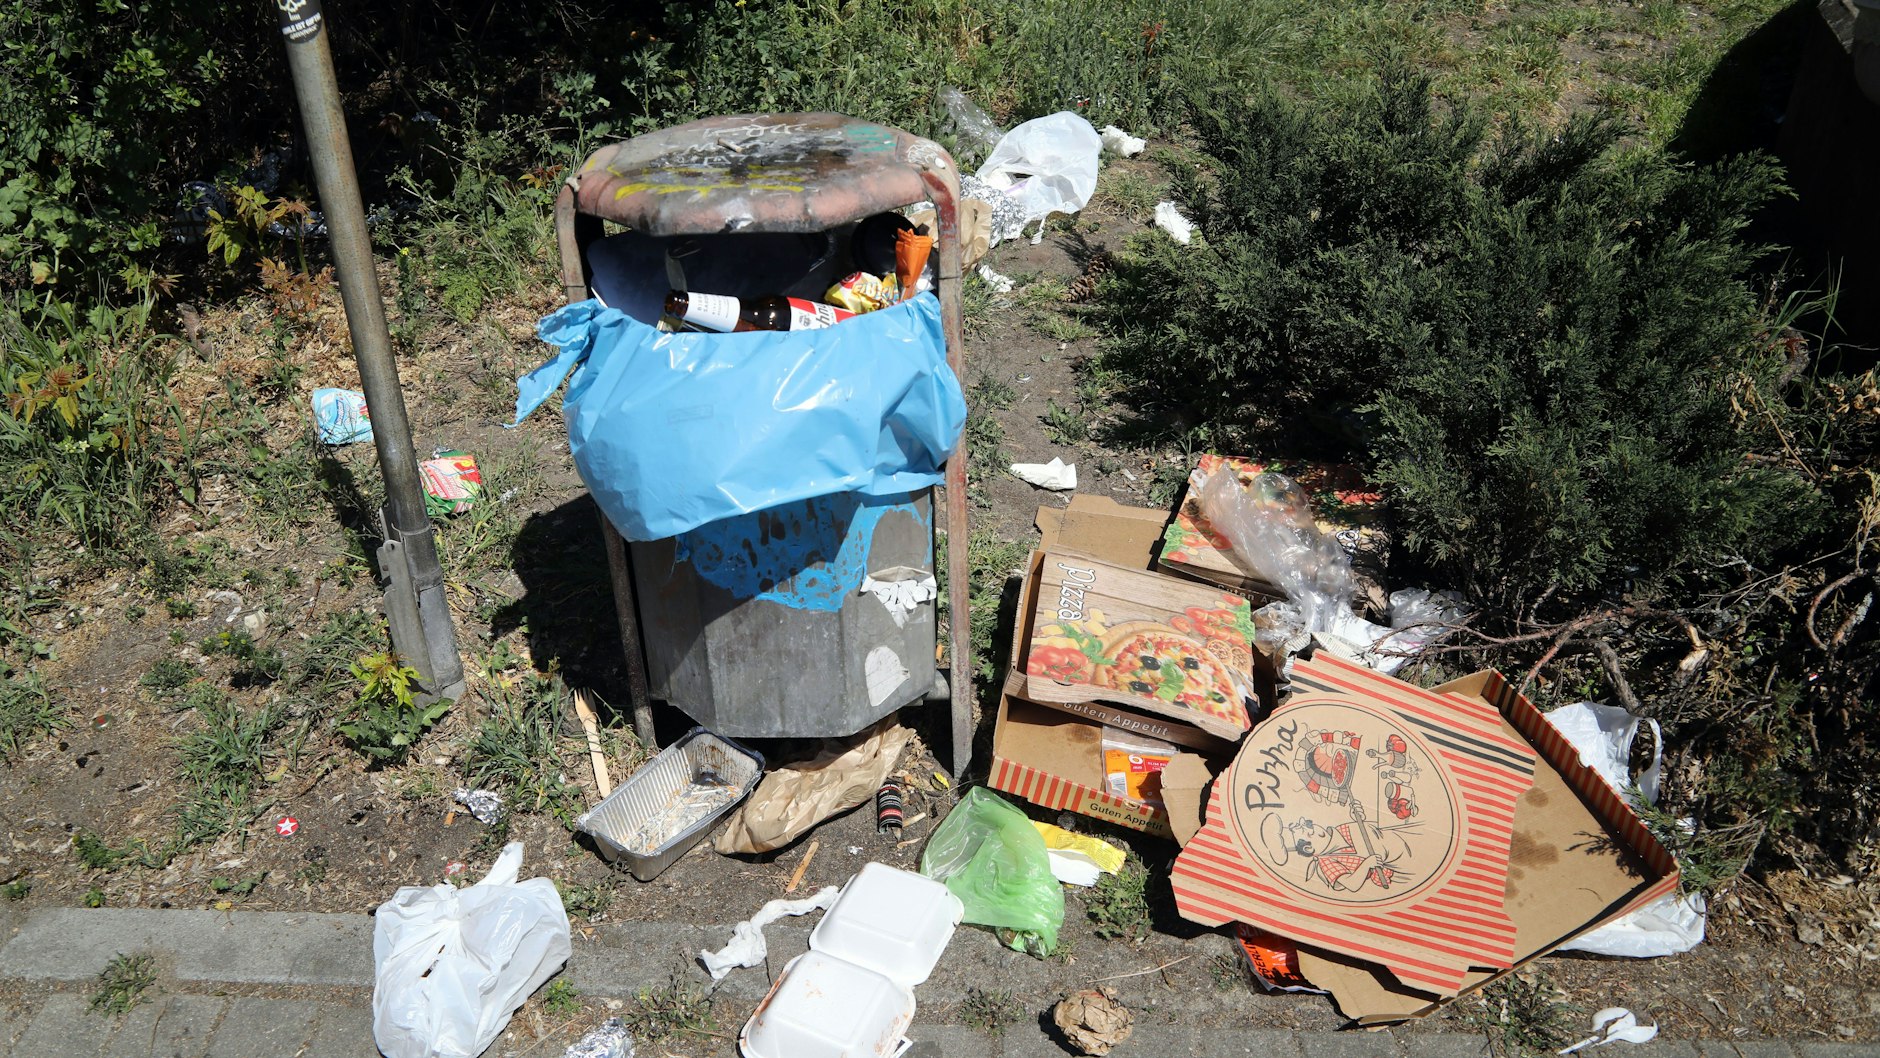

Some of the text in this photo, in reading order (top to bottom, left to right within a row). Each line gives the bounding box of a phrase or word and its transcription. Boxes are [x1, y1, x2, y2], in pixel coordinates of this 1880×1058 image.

[1112, 715, 1169, 736] Appetit
[1089, 802, 1164, 831] Guten Appetit
